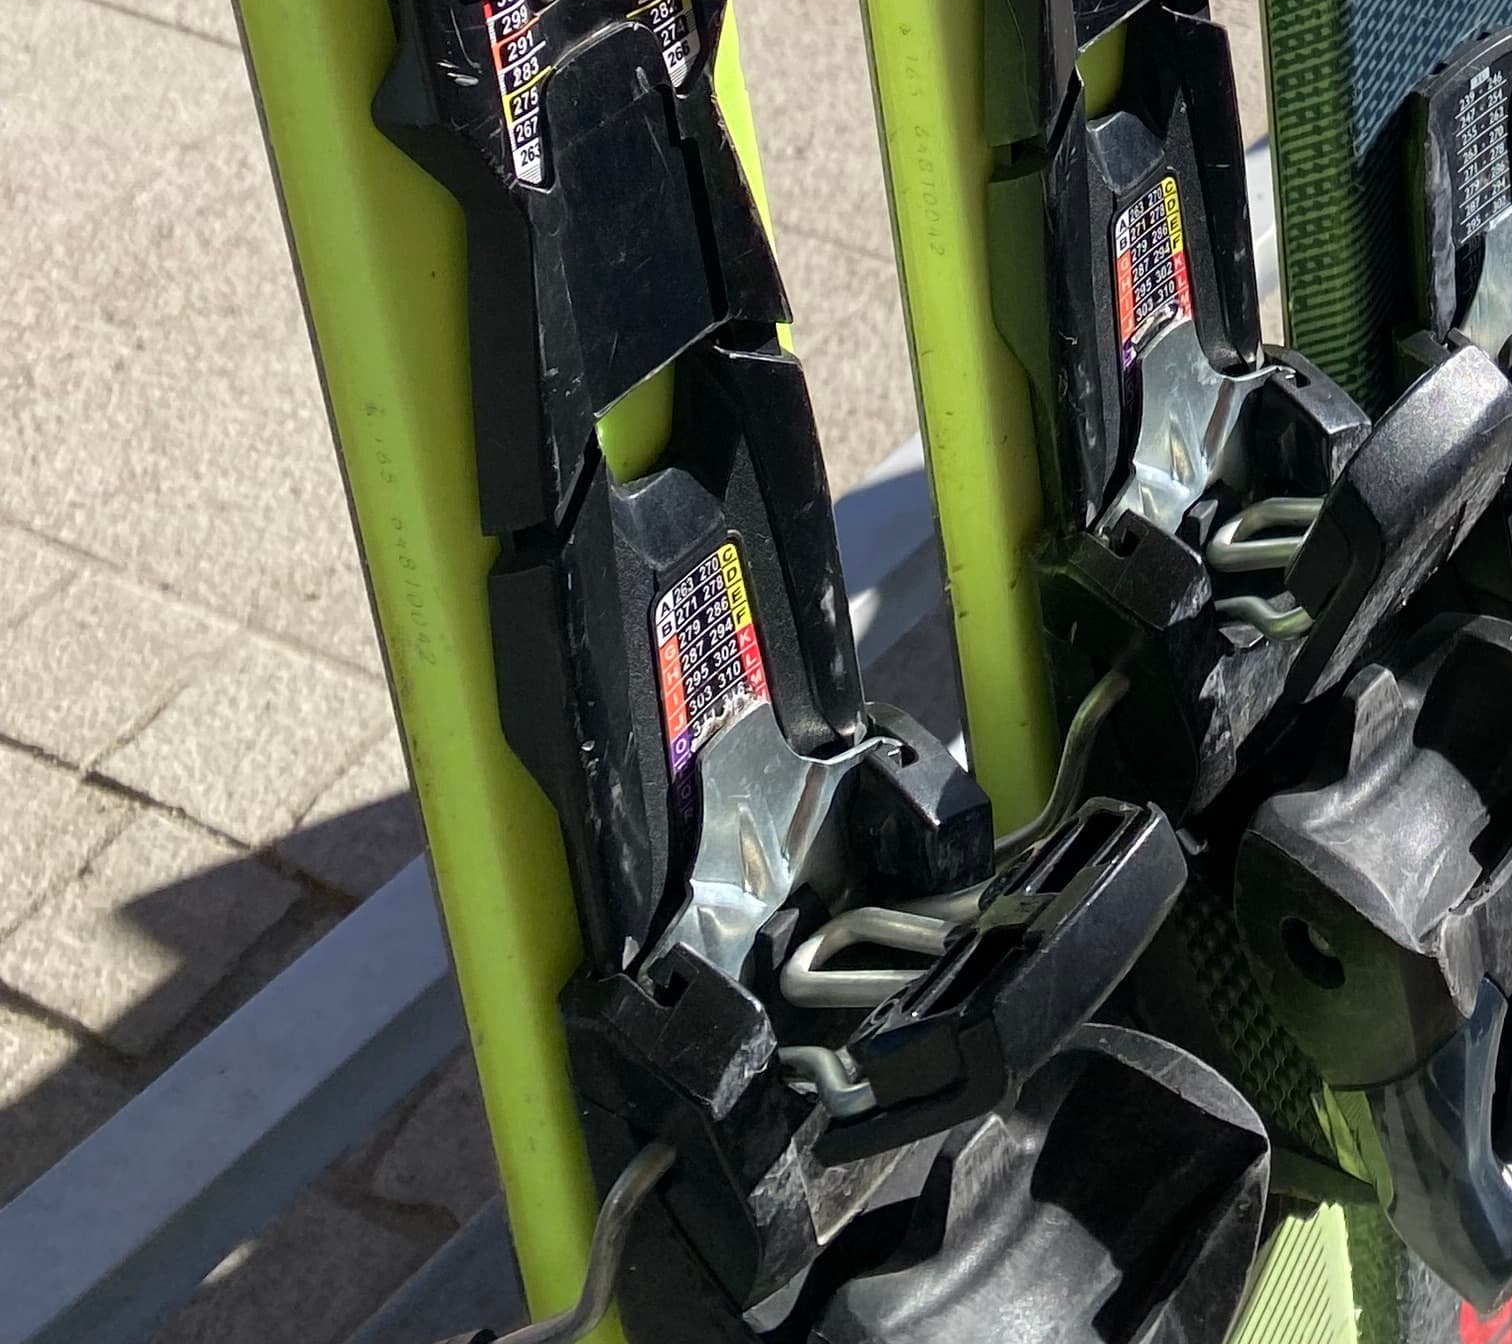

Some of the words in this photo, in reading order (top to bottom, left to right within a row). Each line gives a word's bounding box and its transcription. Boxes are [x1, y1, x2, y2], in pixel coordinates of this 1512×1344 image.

[501, 5, 529, 34] 299
[507, 30, 535, 62] 291
[666, 40, 690, 67] 266
[513, 57, 540, 88] 283
[513, 89, 539, 115] 275
[515, 116, 539, 144] 267
[1489, 125, 1504, 144] 270
[520, 142, 542, 168] 263
[1463, 162, 1478, 182] 271
[1118, 219, 1126, 233] A
[1148, 189, 1162, 207] 270
[1164, 181, 1173, 193] C
[1119, 237, 1128, 251] B
[1130, 219, 1146, 241] 271
[1167, 197, 1176, 211] D
[1131, 239, 1148, 262] 279
[1152, 223, 1168, 245] 286
[1170, 216, 1179, 230] E
[1132, 258, 1150, 282] 287
[1153, 242, 1171, 264] 294
[1173, 236, 1181, 250] F
[1134, 278, 1152, 302] 295
[1155, 260, 1173, 283] 302
[1136, 299, 1154, 322] 303
[1157, 280, 1175, 303] 310
[1178, 275, 1186, 287] L
[660, 602, 670, 618] A
[674, 577, 695, 604] 263
[699, 556, 719, 581] 270
[722, 547, 733, 563] C
[662, 621, 673, 635] B
[675, 595, 698, 625] 271
[702, 573, 724, 601] 278
[726, 565, 738, 582] D
[663, 644, 676, 660] G
[679, 620, 701, 650] 279
[706, 596, 729, 624] 286
[731, 587, 741, 603] E
[666, 667, 679, 685] H
[681, 640, 704, 672] 287
[709, 618, 733, 646] 294
[736, 608, 746, 625] F
[685, 667, 709, 695] 295
[713, 639, 738, 668] 302
[740, 629, 751, 645] K
[674, 717, 684, 731] J
[689, 688, 713, 718] 303
[718, 660, 742, 689] 310
[746, 651, 757, 666] L
[675, 737, 687, 754] O
